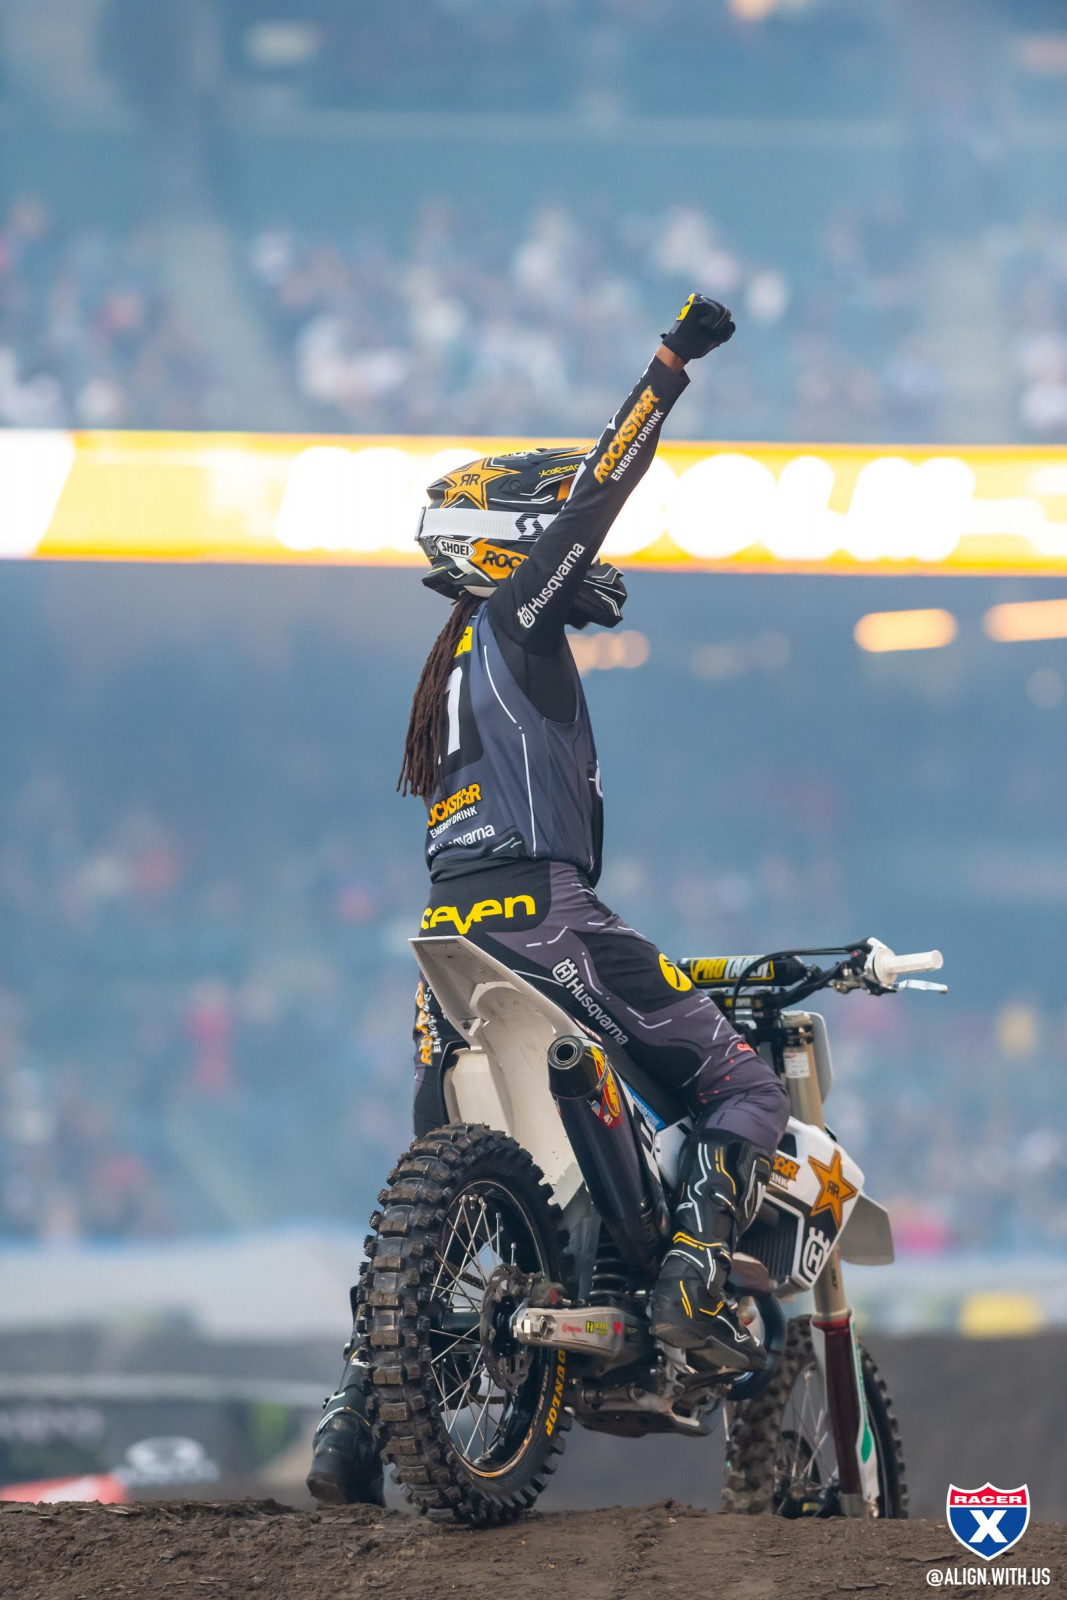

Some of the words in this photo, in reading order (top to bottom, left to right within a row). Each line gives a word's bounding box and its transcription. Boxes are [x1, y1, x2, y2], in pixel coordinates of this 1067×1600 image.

[593, 388, 659, 483] ROCKSTAR
[611, 439, 642, 481] ENERGY
[638, 409, 664, 441] DRINK
[441, 541, 470, 556] SHOEI
[482, 550, 525, 570] ROC
[528, 543, 585, 614] Husqvarna
[452, 805, 478, 825] DRINK
[566, 977, 629, 1045] Husqvarna
[546, 1349, 566, 1436] DUNLOP
